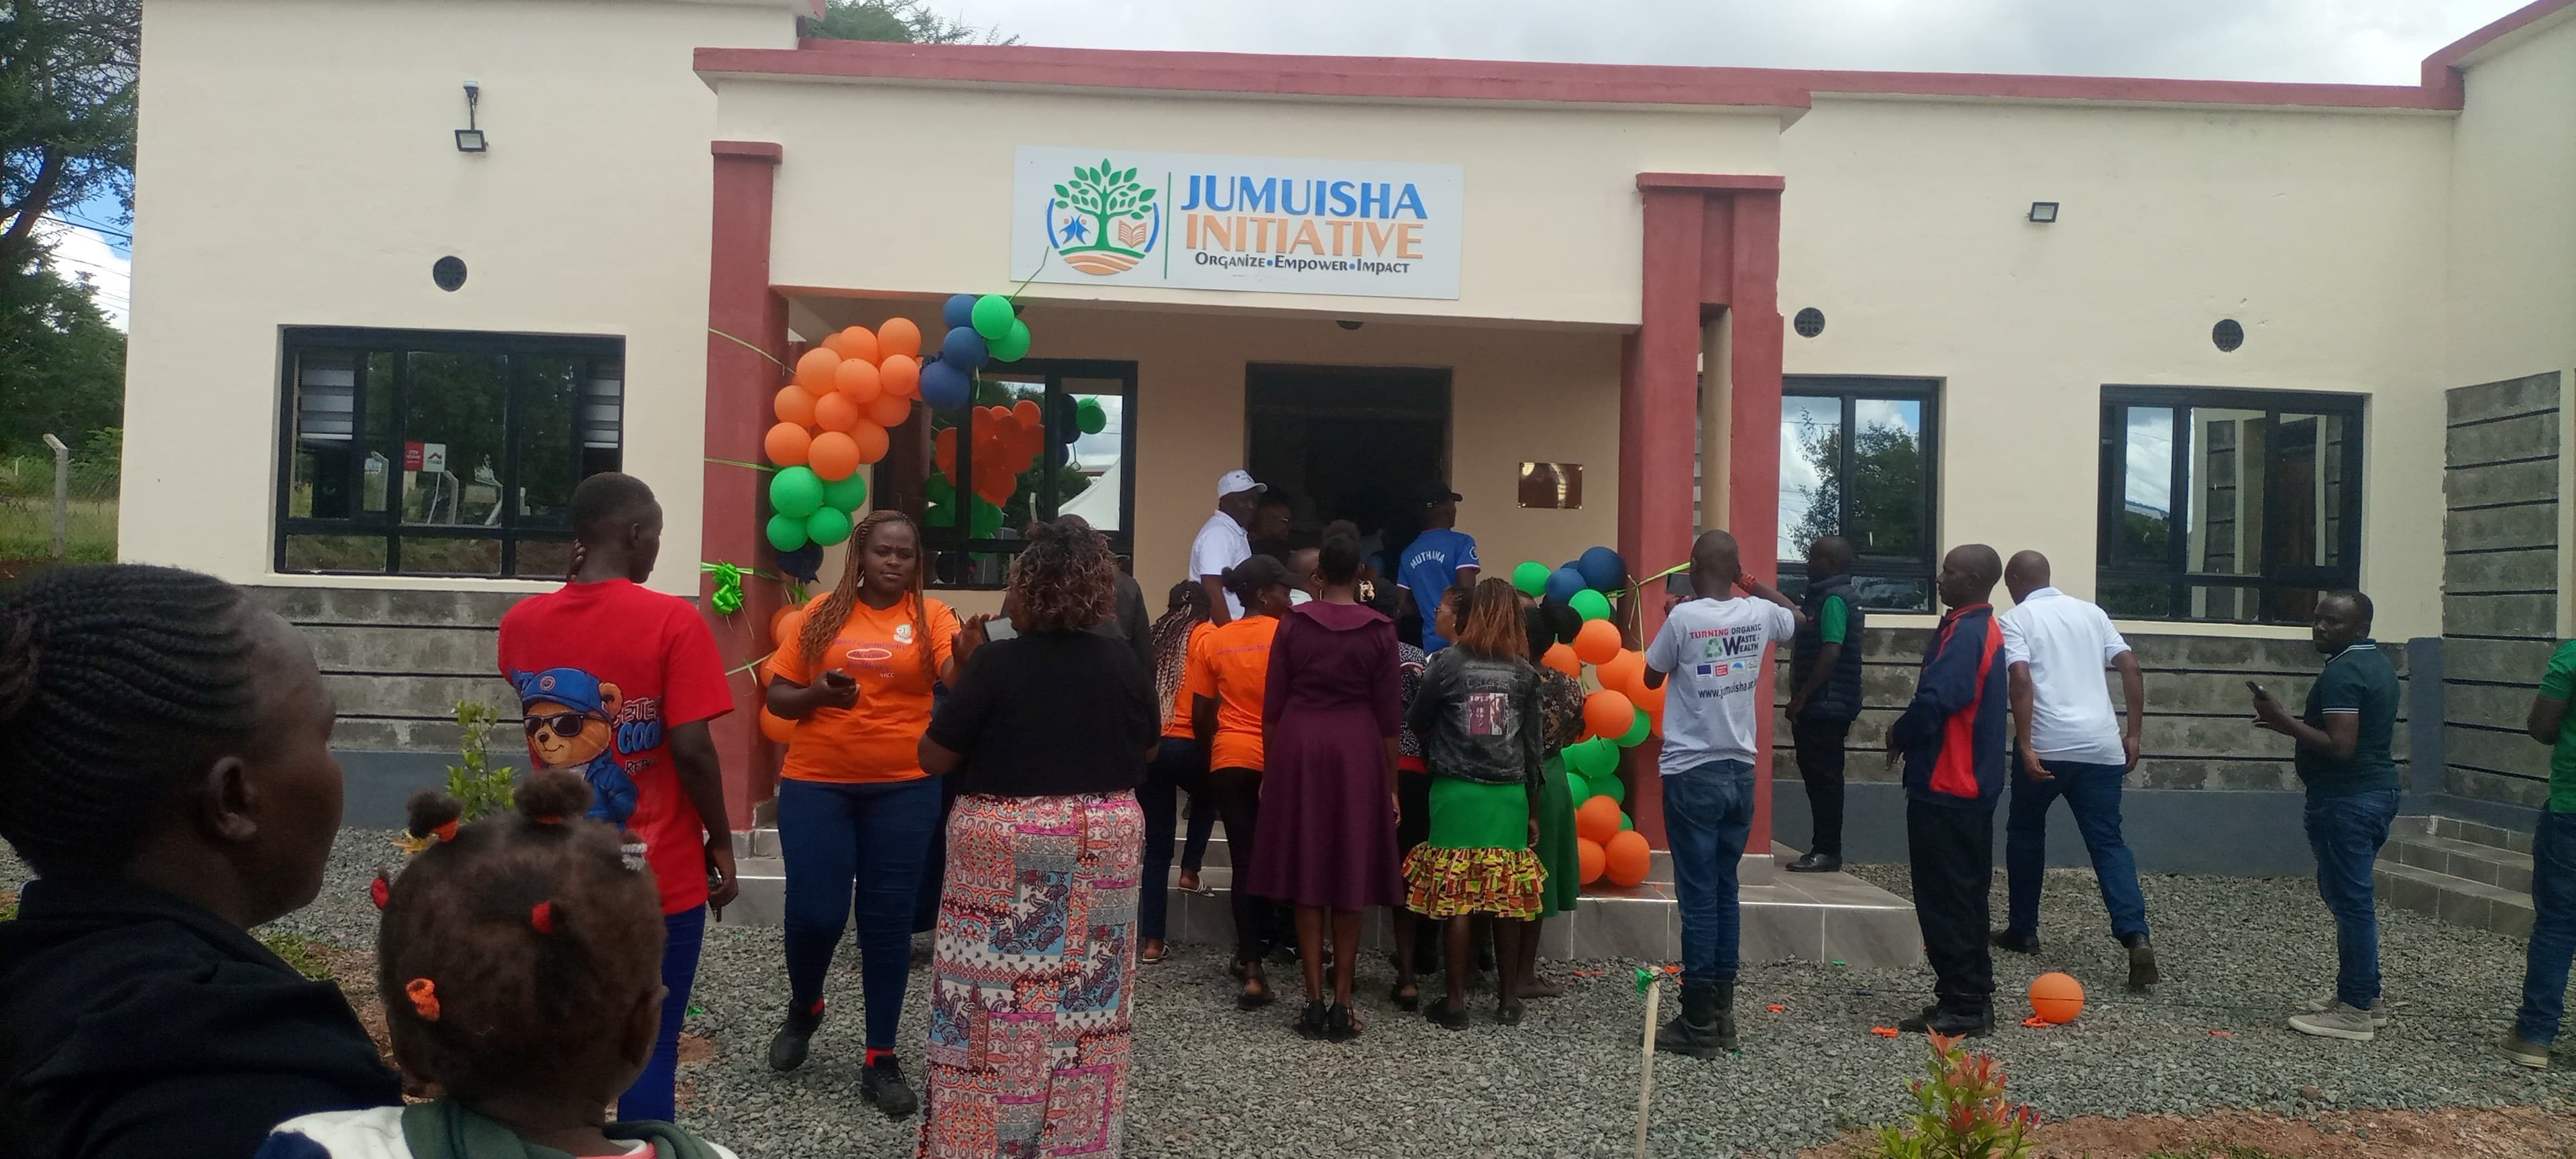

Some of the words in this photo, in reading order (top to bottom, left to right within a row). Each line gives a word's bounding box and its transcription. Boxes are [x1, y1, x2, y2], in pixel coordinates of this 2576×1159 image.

[1180, 174, 1428, 219] JUMUISHA
[1185, 213, 1424, 259] INITIATIVE
[1689, 628, 1729, 639] TURNING
[1731, 623, 1762, 634] ORGANIC
[618, 721, 663, 754] COO
